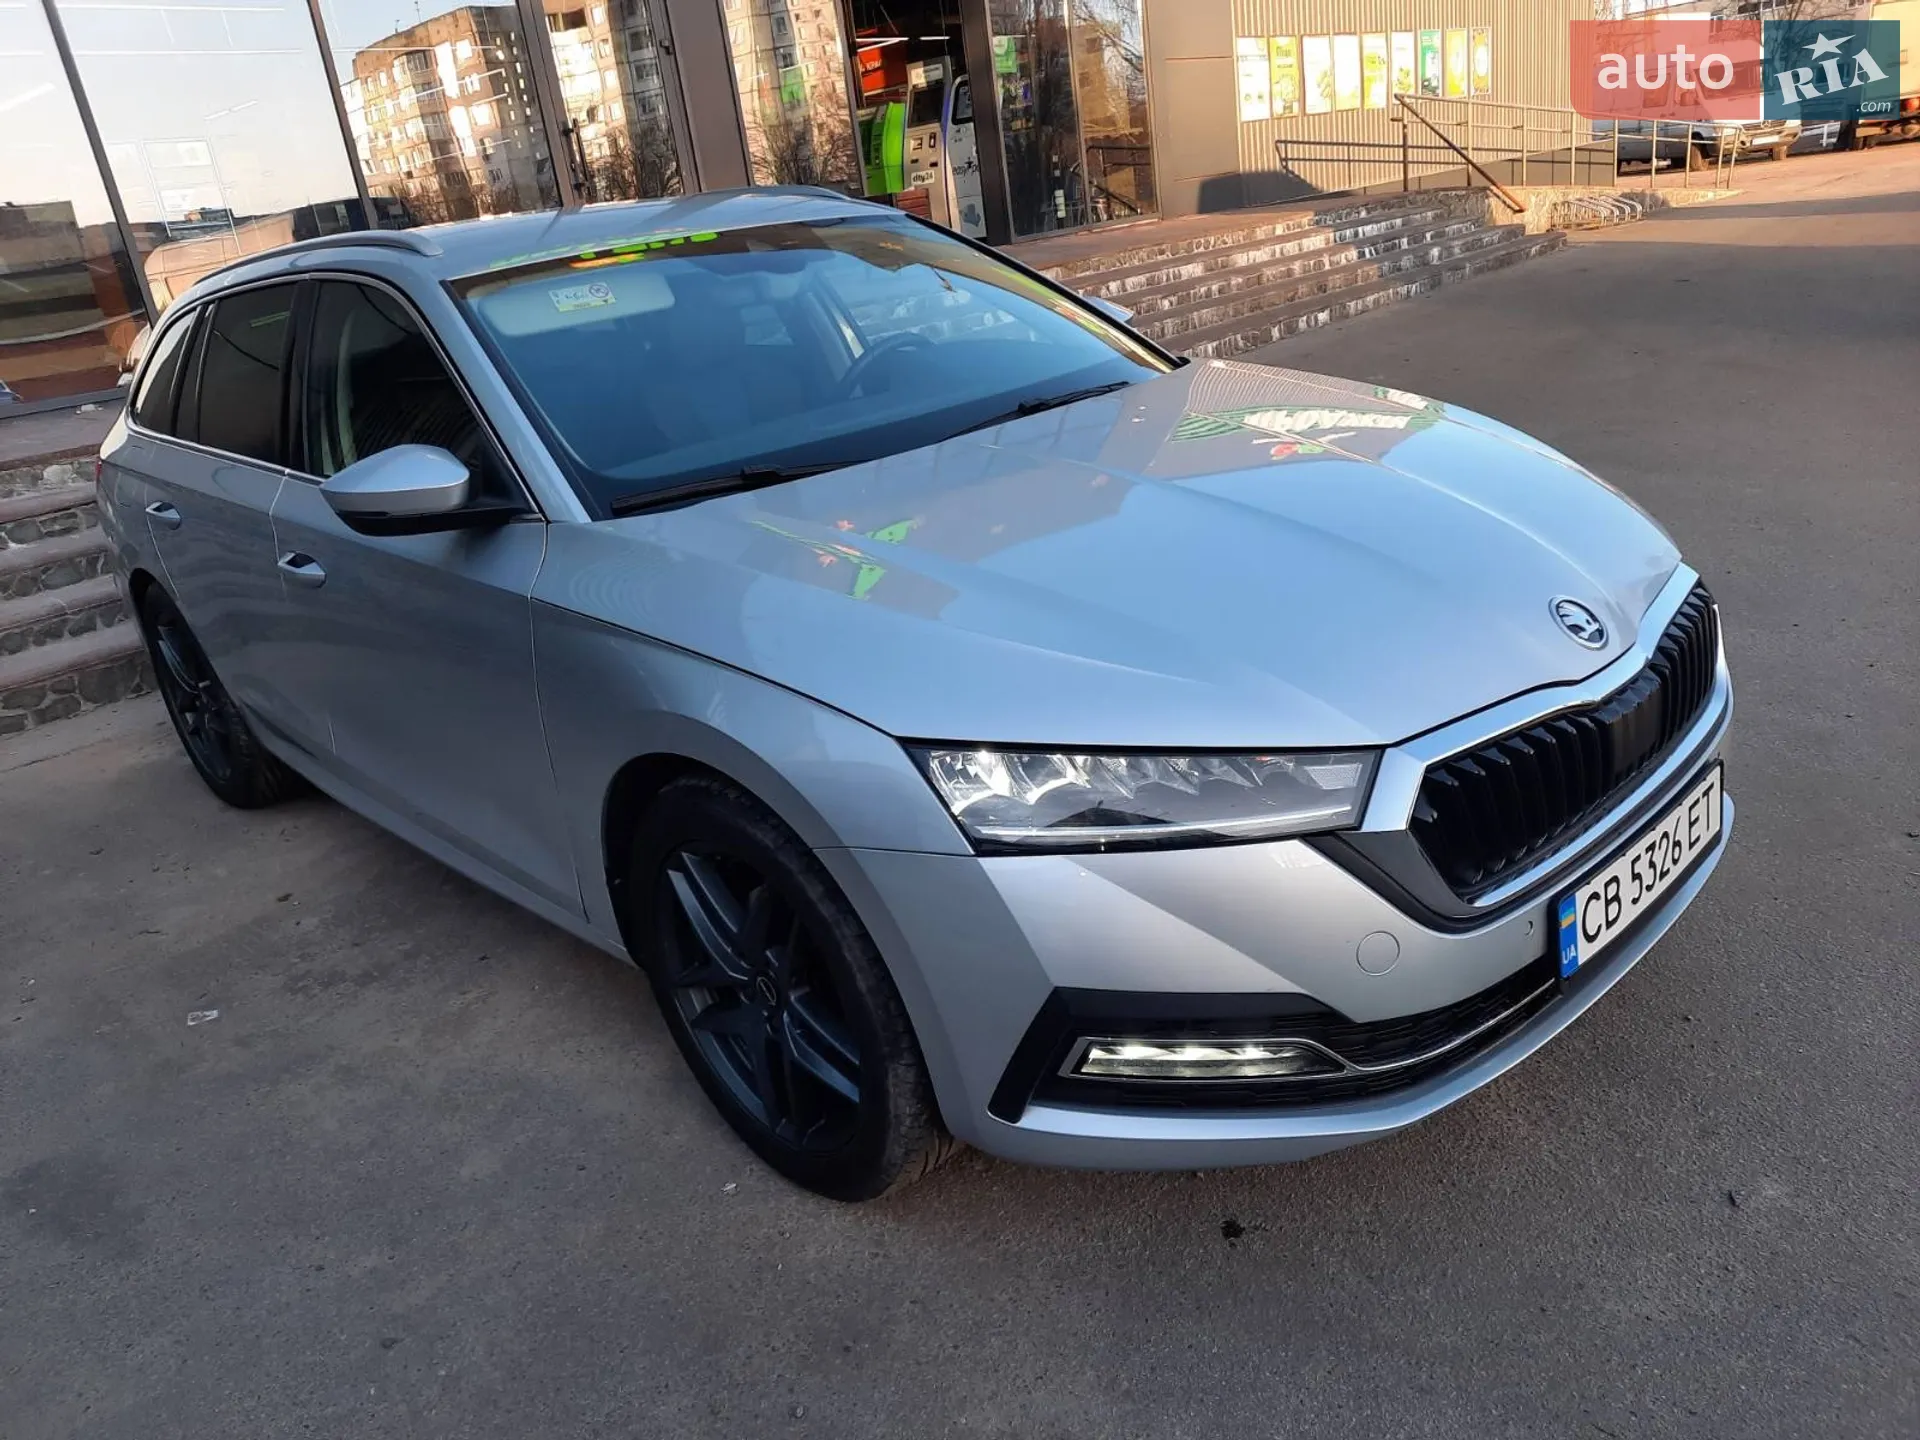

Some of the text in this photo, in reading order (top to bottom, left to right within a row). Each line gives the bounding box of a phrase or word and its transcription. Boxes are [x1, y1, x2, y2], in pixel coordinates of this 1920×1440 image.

[1582, 782, 1715, 943] CB 5326 ET
[1562, 946, 1577, 964] UA
